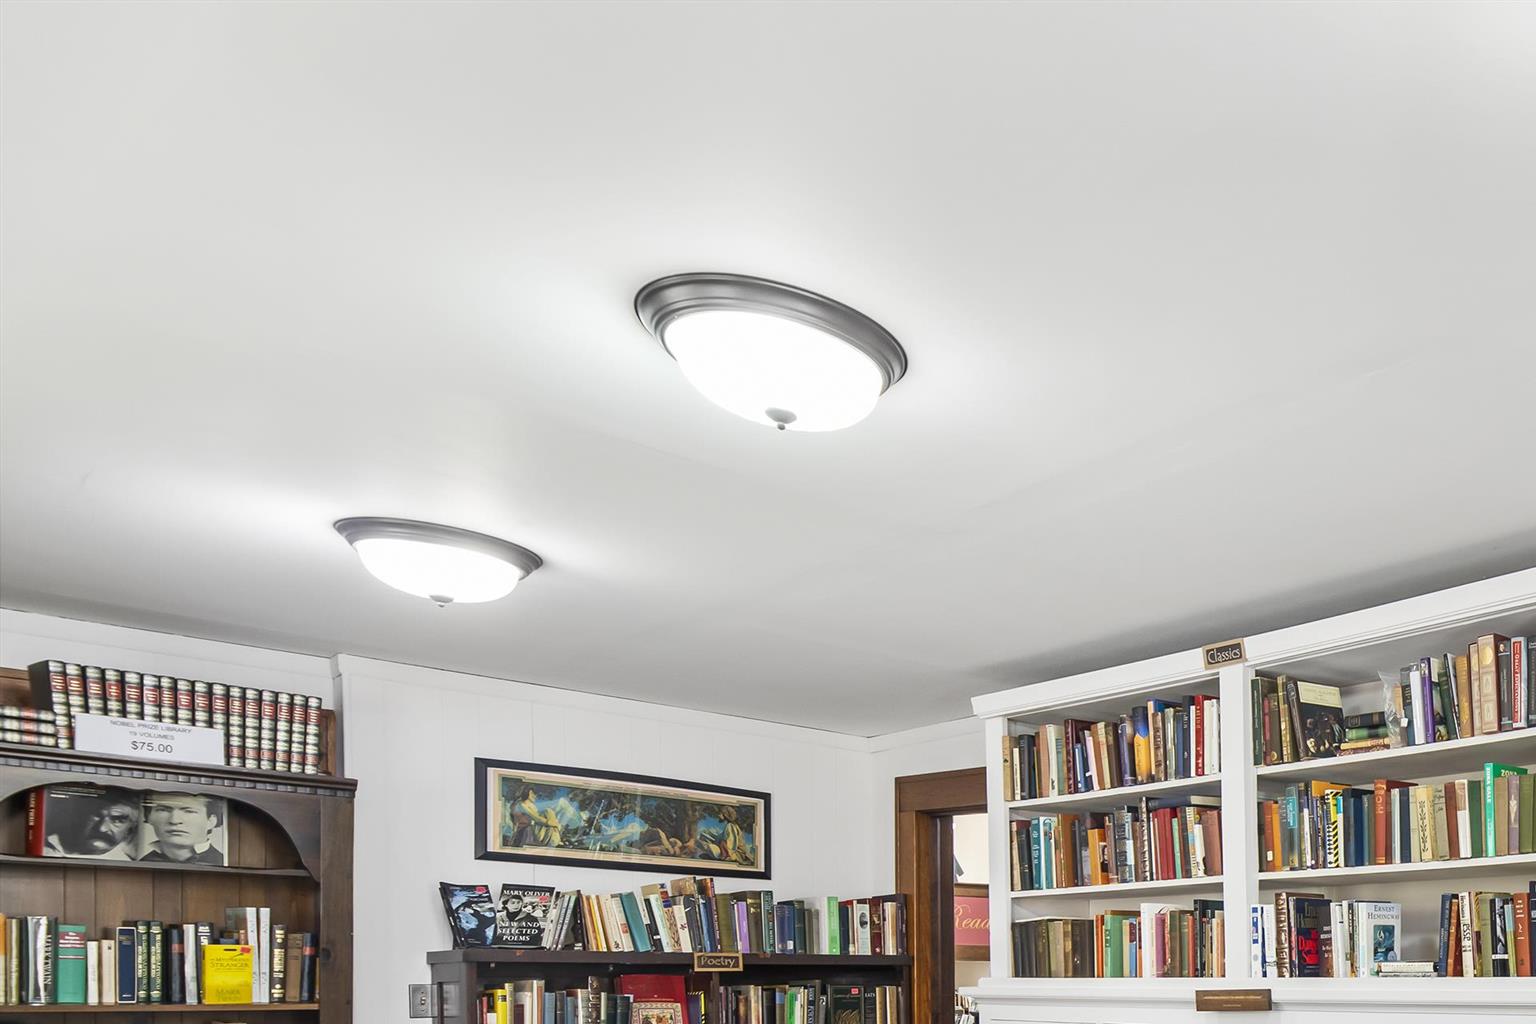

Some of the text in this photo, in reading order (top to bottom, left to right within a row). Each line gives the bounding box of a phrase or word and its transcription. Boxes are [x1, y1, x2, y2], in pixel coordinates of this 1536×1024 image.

[1207, 648, 1242, 664] Classics
[110, 719, 193, 734] NOBEL PRIZE LIBRARY
[138, 732, 175, 741] VOLUMES
[131, 740, 174, 754] $75.00
[1373, 904, 1395, 912] ERNEST
[1368, 912, 1399, 920] HEMINGWAY
[210, 961, 249, 969] STRANGER
[701, 956, 736, 968] Poetry
